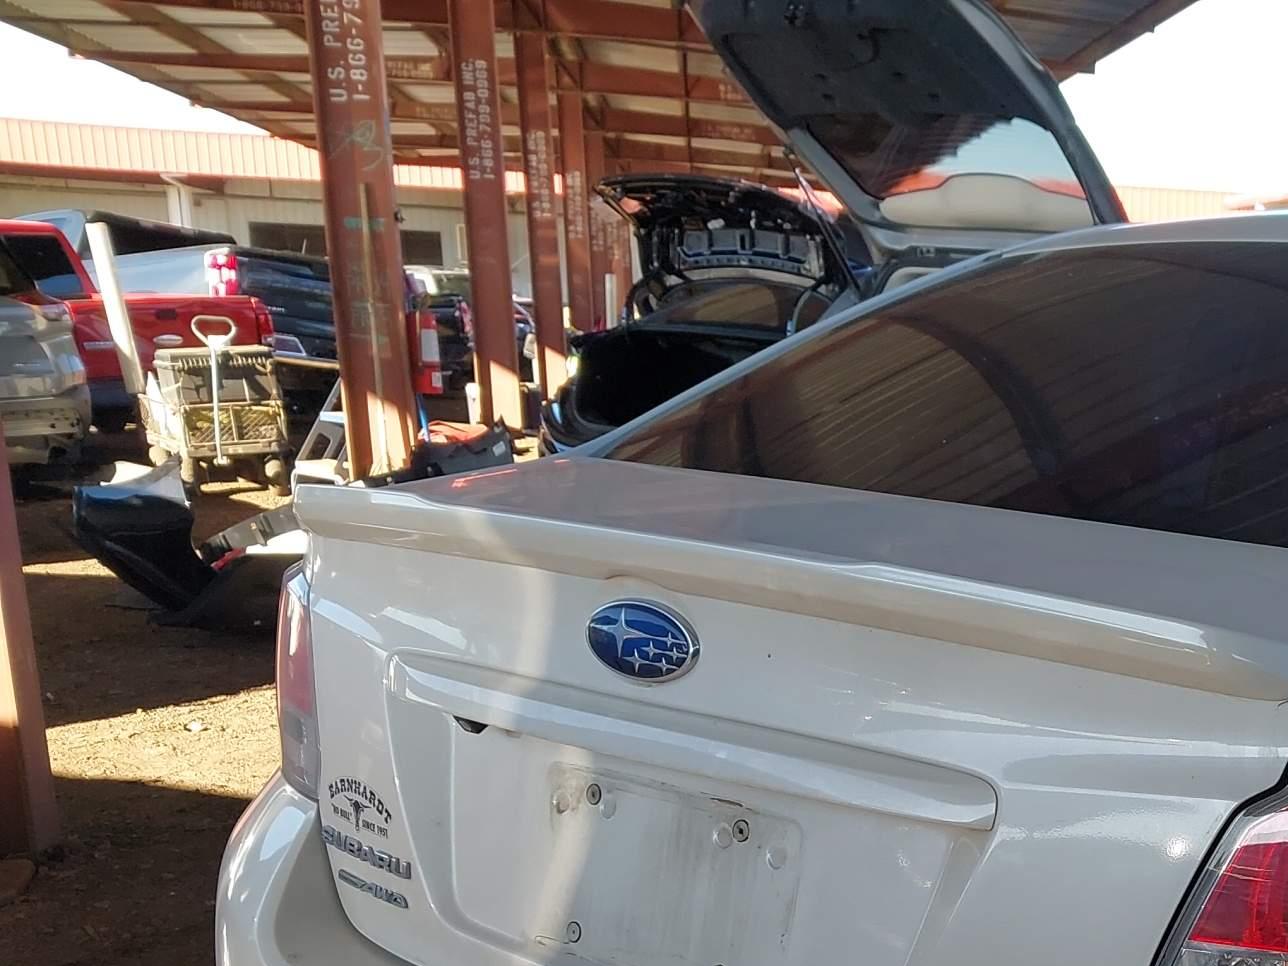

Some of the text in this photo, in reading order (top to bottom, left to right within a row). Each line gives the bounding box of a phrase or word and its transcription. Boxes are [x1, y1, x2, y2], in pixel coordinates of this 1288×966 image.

[320, 0, 348, 101] U.S. PRE
[328, 777, 392, 825] EARNHARDT
[321, 824, 412, 880] SUBARU
